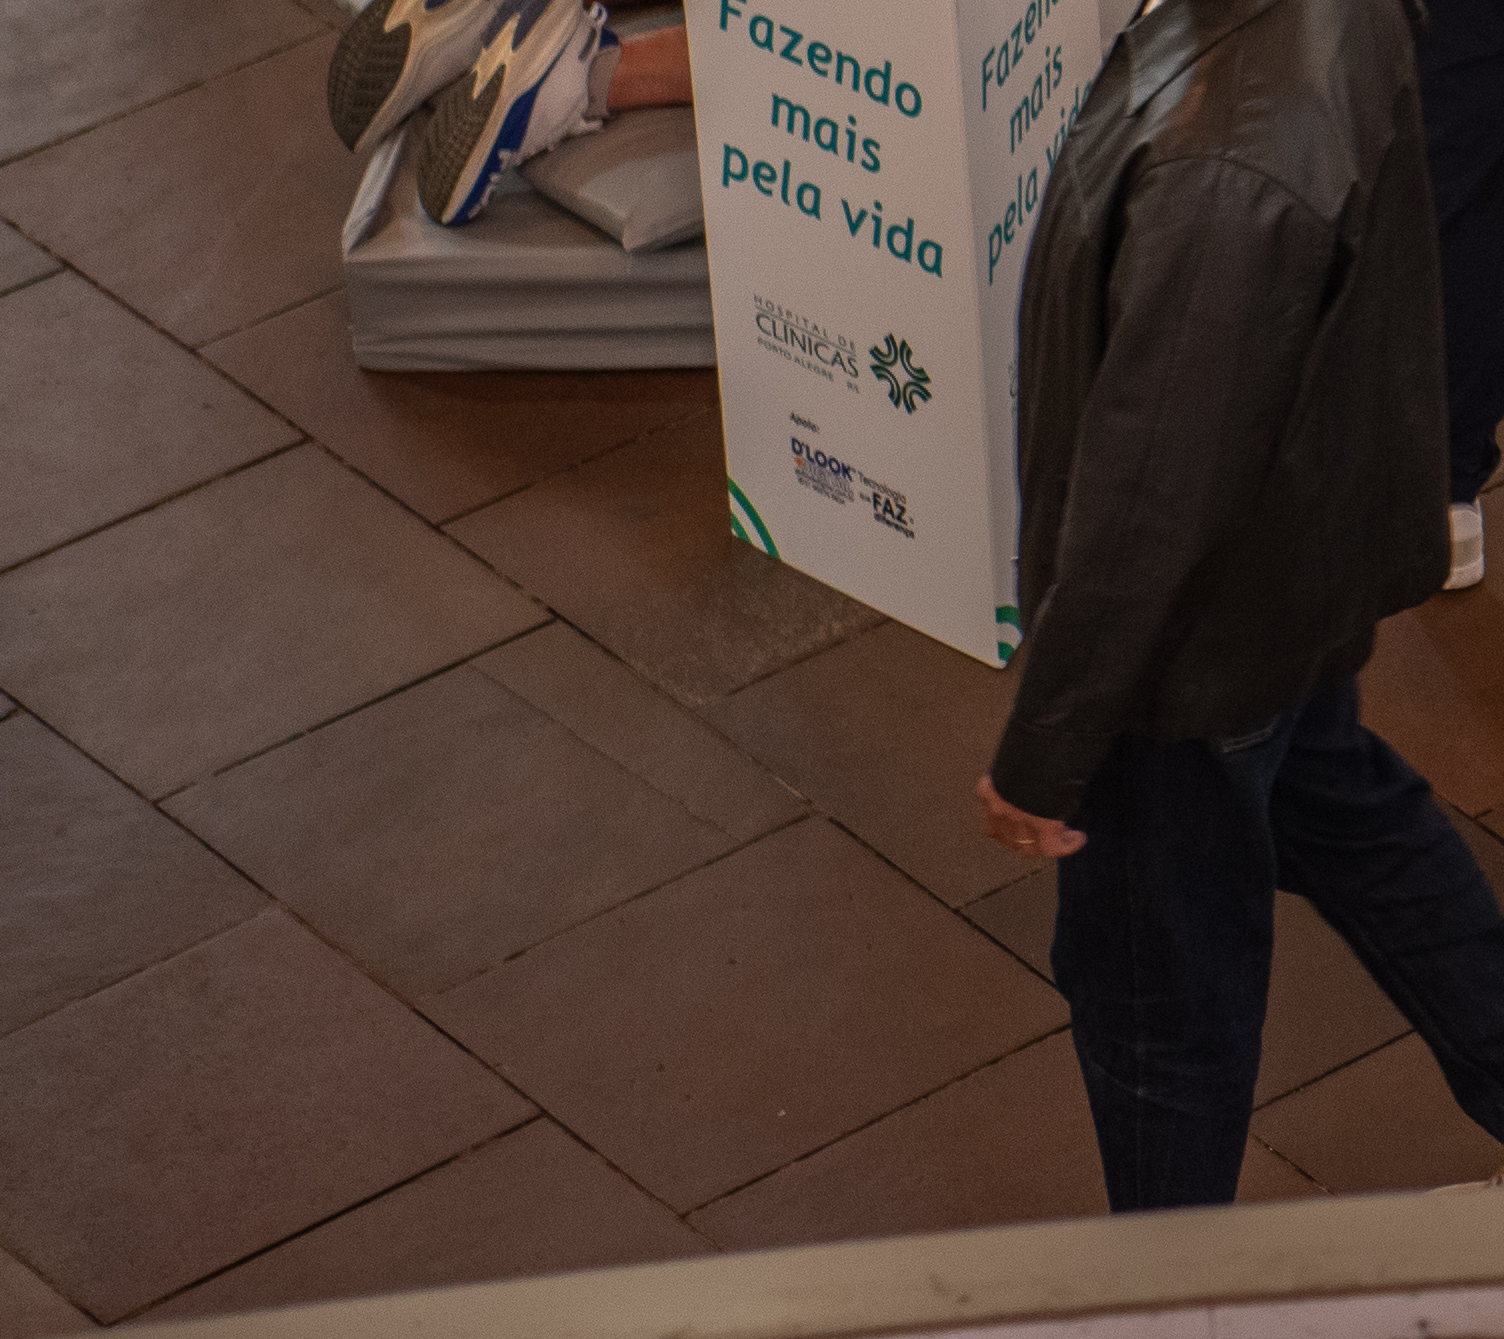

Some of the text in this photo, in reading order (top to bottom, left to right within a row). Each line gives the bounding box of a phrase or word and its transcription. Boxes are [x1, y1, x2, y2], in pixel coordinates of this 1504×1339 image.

[771, 92, 881, 173] mais
[1008, 45, 1063, 154] mais
[722, 143, 943, 279] pela vida
[987, 167, 1040, 286] pela
[753, 293, 830, 338] HOSPITAL
[757, 336, 793, 361] PORTO
[793, 353, 834, 382] ALEGRE
[872, 492, 908, 525] FAZ
